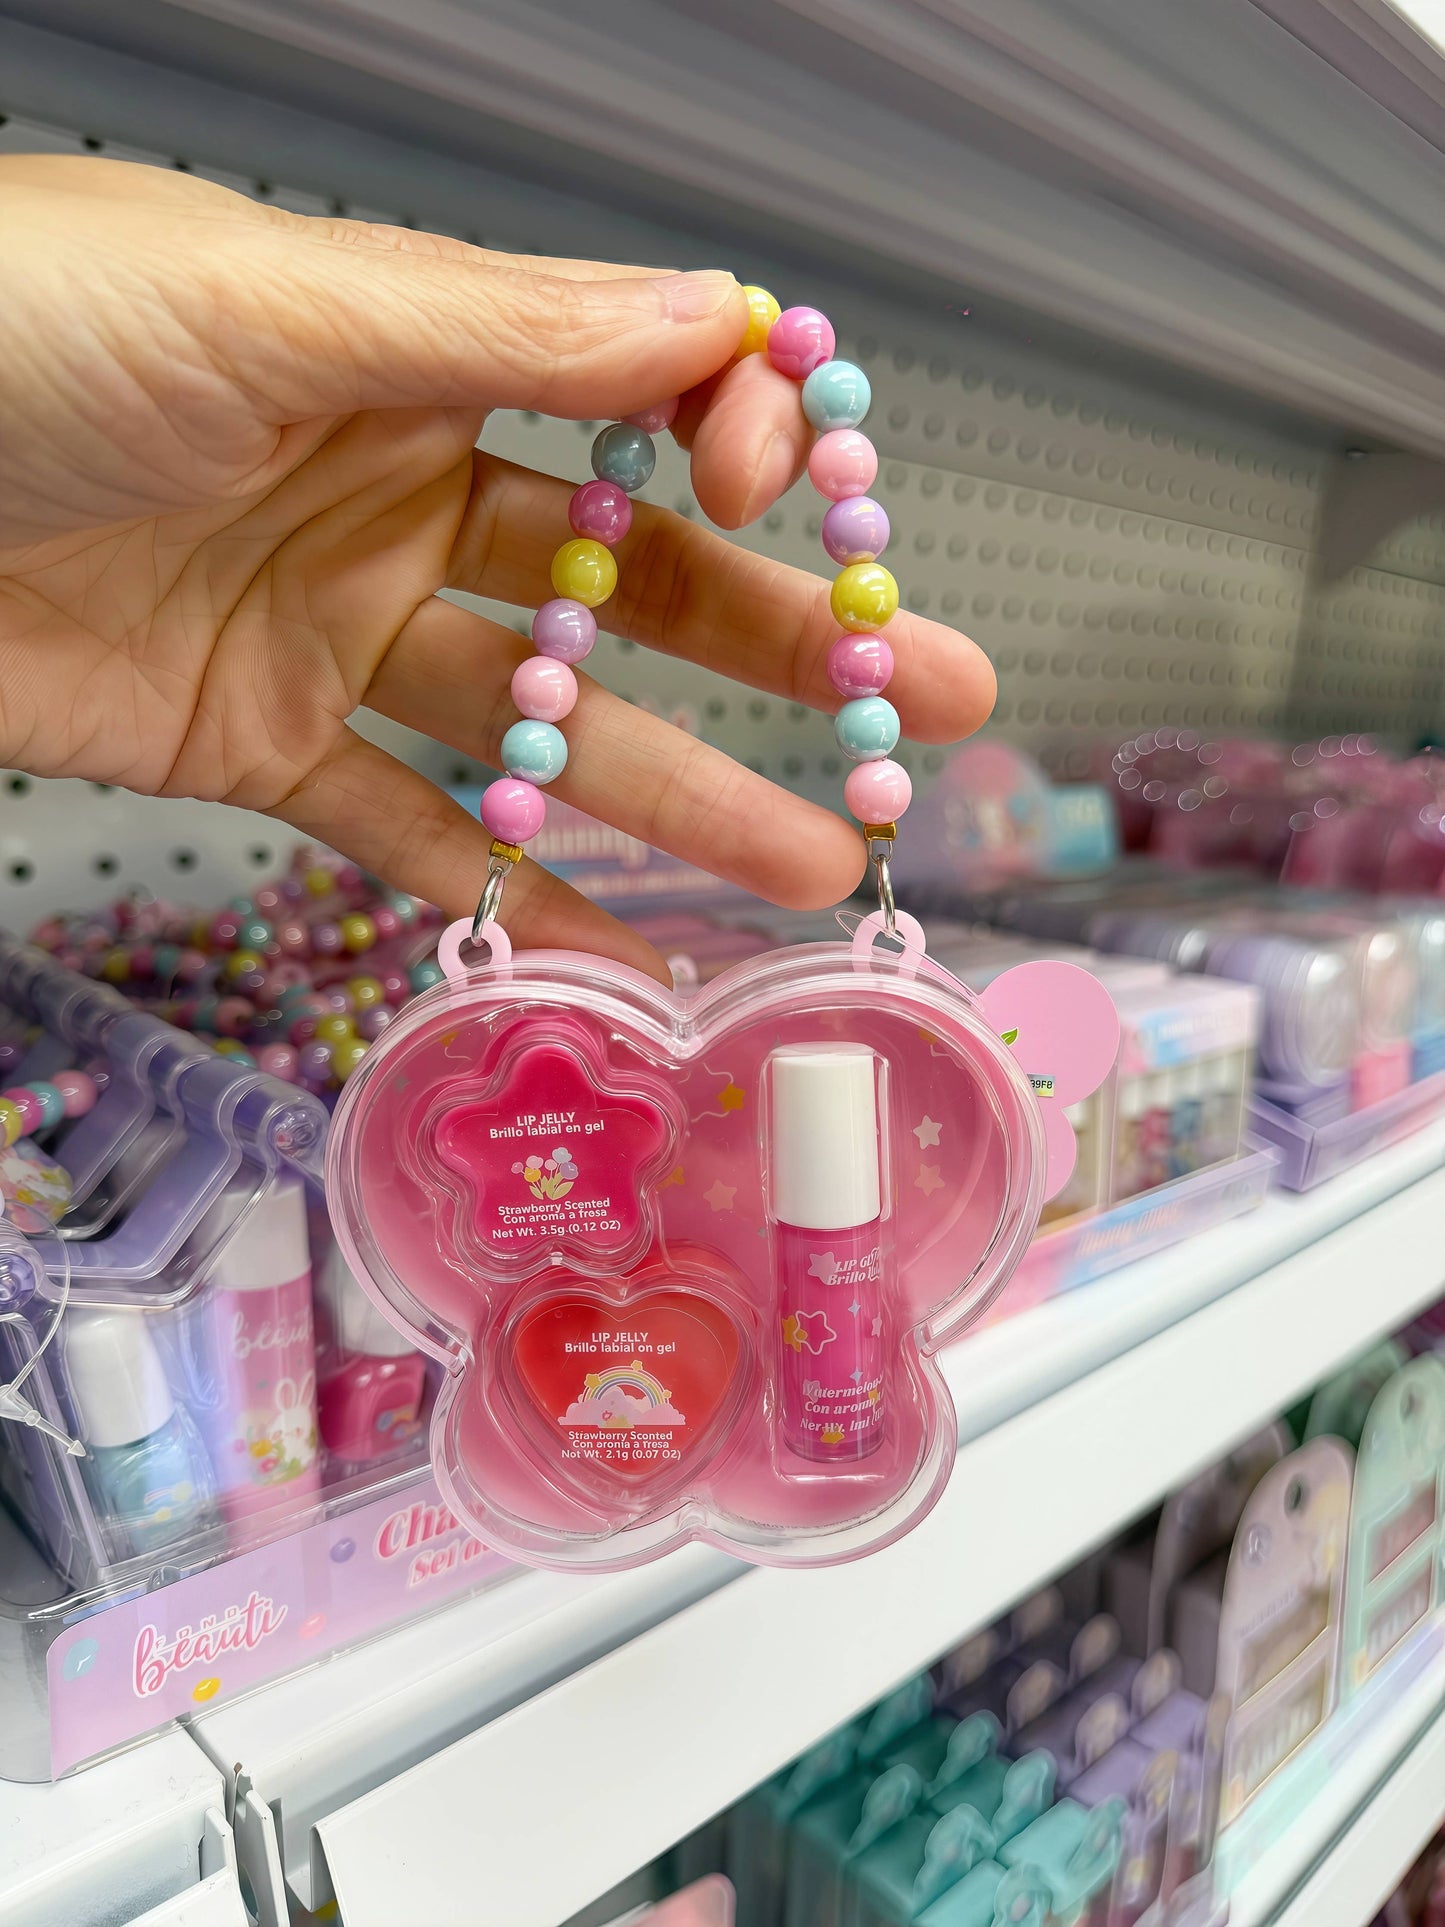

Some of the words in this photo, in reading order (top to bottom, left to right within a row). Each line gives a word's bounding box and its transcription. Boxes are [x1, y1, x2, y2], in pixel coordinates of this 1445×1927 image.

[516, 1115, 536, 1126] LIP
[539, 1112, 575, 1125] JELLY
[489, 1126, 523, 1139] Brillo
[527, 1123, 562, 1136] labial
[565, 1124, 581, 1133] en
[585, 1119, 605, 1135] gel
[498, 1203, 561, 1216] Strawberry
[564, 1197, 610, 1210] Scented
[503, 1215, 526, 1224] Con
[529, 1213, 566, 1223] aroma
[568, 1211, 576, 1219] a
[492, 1229, 514, 1239] Net
[516, 1227, 537, 1237] Wt.
[568, 1221, 597, 1234] (0.12
[834, 1259, 858, 1273] LIP
[827, 1271, 866, 1286] Brillo
[591, 1332, 611, 1343] LIP
[613, 1332, 649, 1343] JELLY
[564, 1342, 597, 1353] Brillo
[601, 1342, 634, 1353] labial
[656, 1341, 676, 1355] gel
[805, 1401, 830, 1414] Con
[568, 1431, 627, 1441] Strawberry
[572, 1440, 593, 1448] Con
[583, 1450, 602, 1459] Wt.
[605, 1450, 629, 1461] 2.1g
[631, 1449, 659, 1460] (0.07
[135, 1592, 286, 1695] beauti
